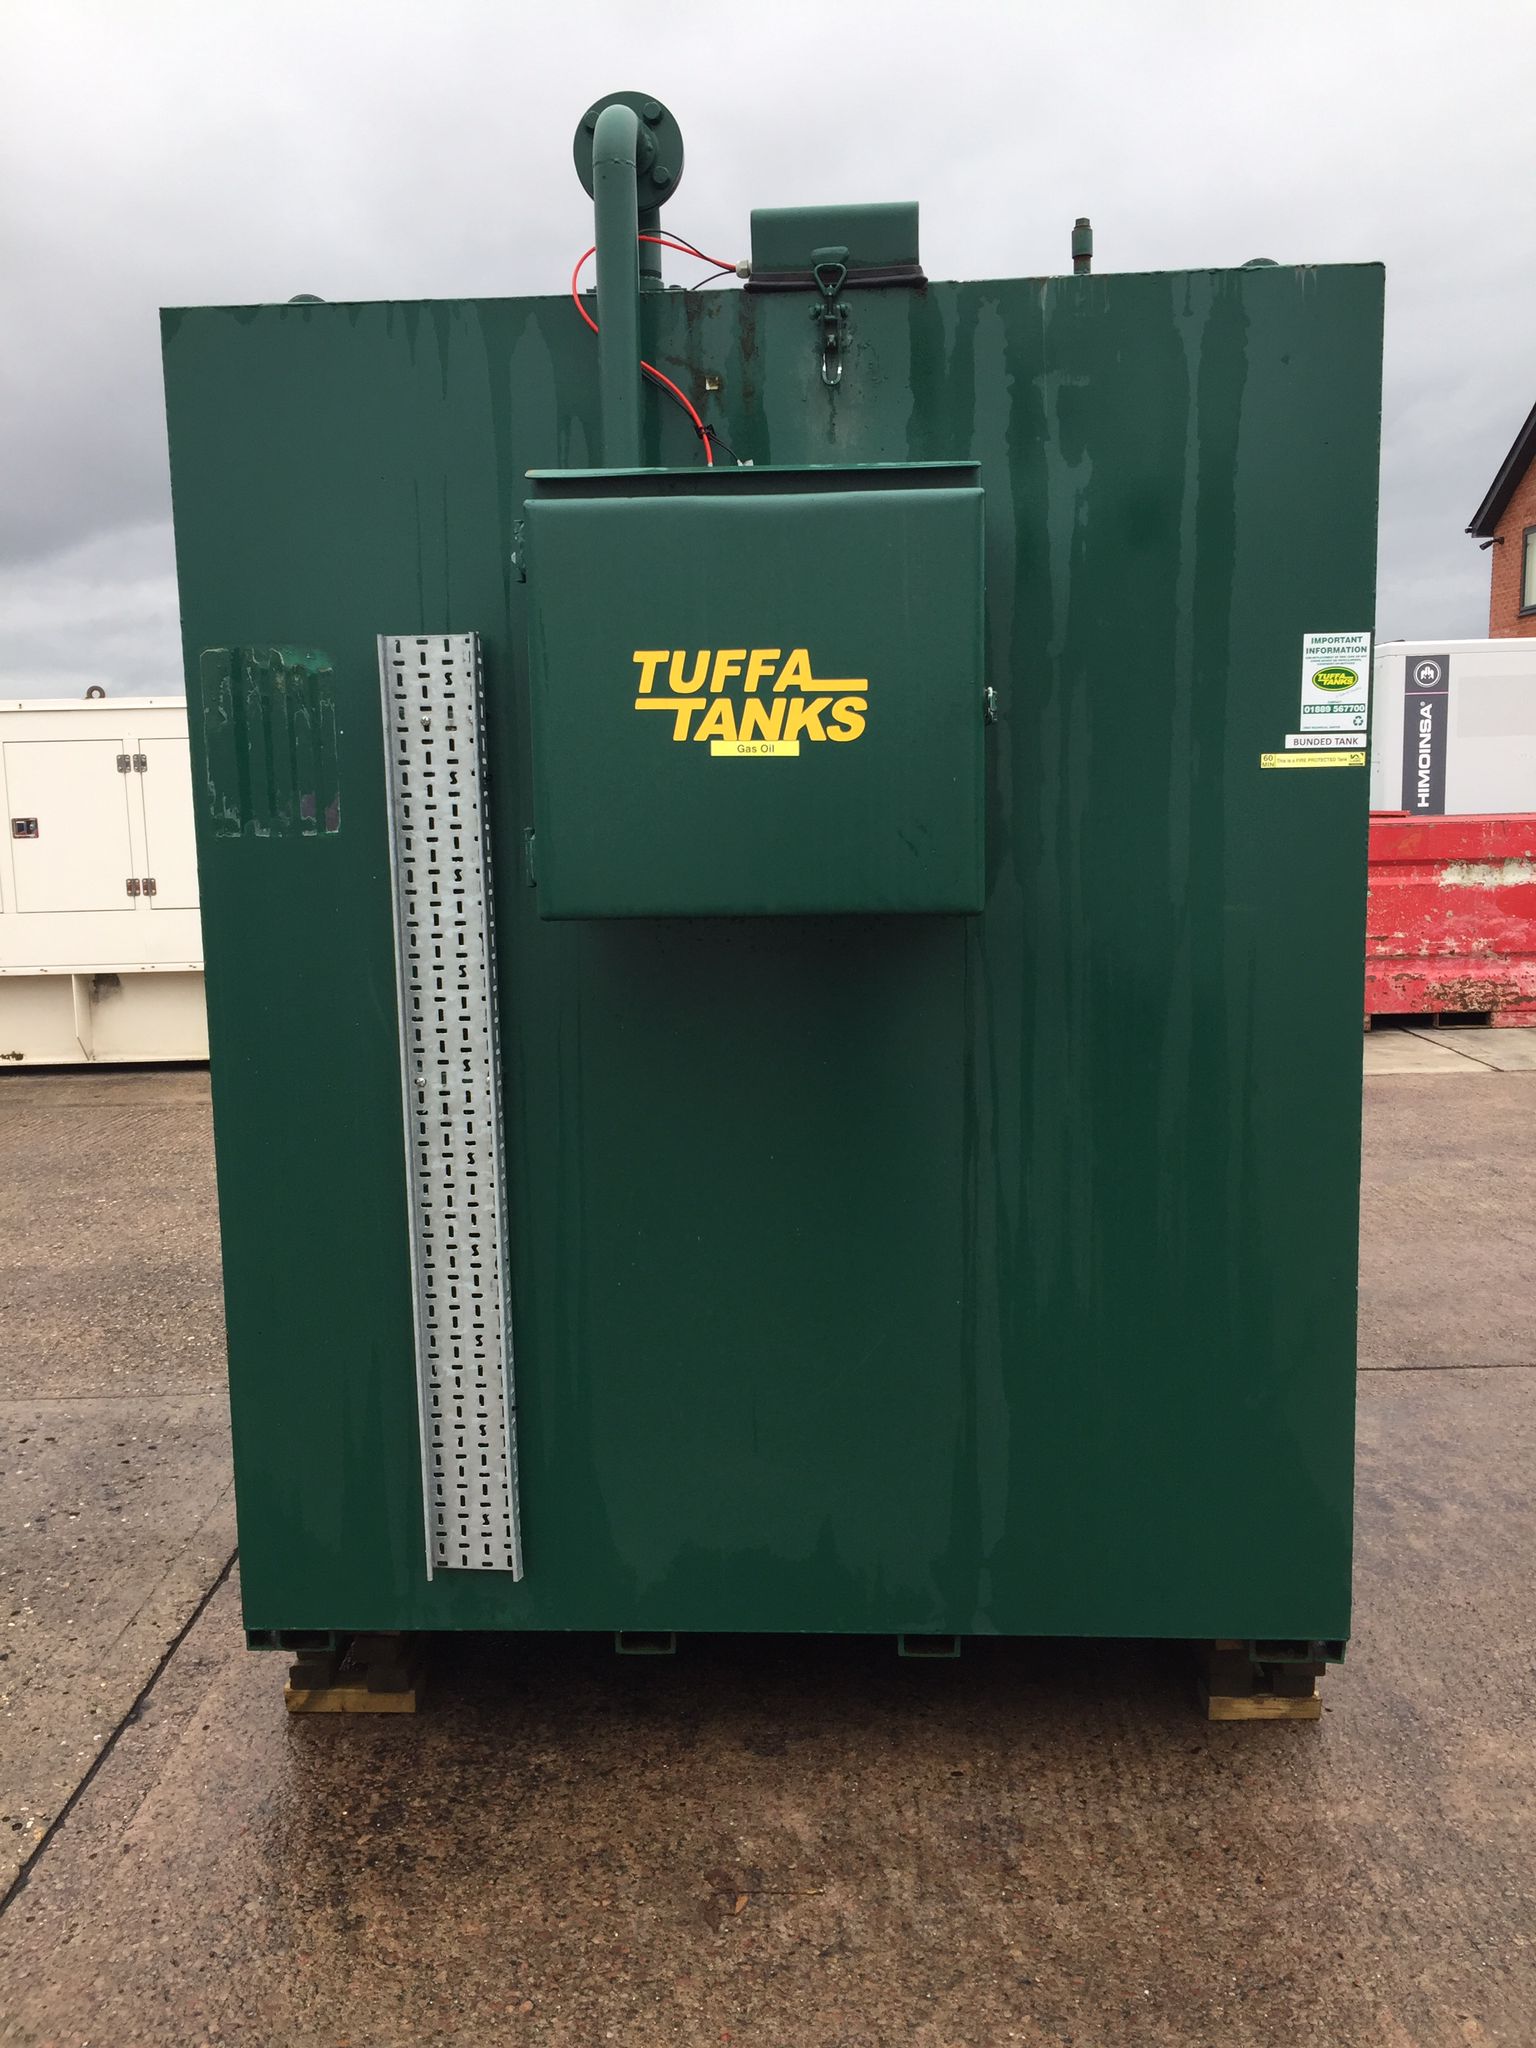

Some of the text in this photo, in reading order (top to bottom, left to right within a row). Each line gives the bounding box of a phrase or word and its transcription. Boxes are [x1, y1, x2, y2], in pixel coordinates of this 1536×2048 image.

[1311, 636, 1363, 645] IMPORTANT
[1306, 645, 1368, 655] INFORMATION
[632, 648, 869, 694] TUFFA
[1317, 676, 1354, 686] TANKS
[1332, 704, 1365, 713] 567700
[634, 695, 869, 742] TANKS
[1293, 737, 1359, 746] BUNDED TANK
[736, 743, 776, 754] Gas Oil
[1263, 754, 1274, 762] 60
[1417, 703, 1433, 808] HIMOINSA
